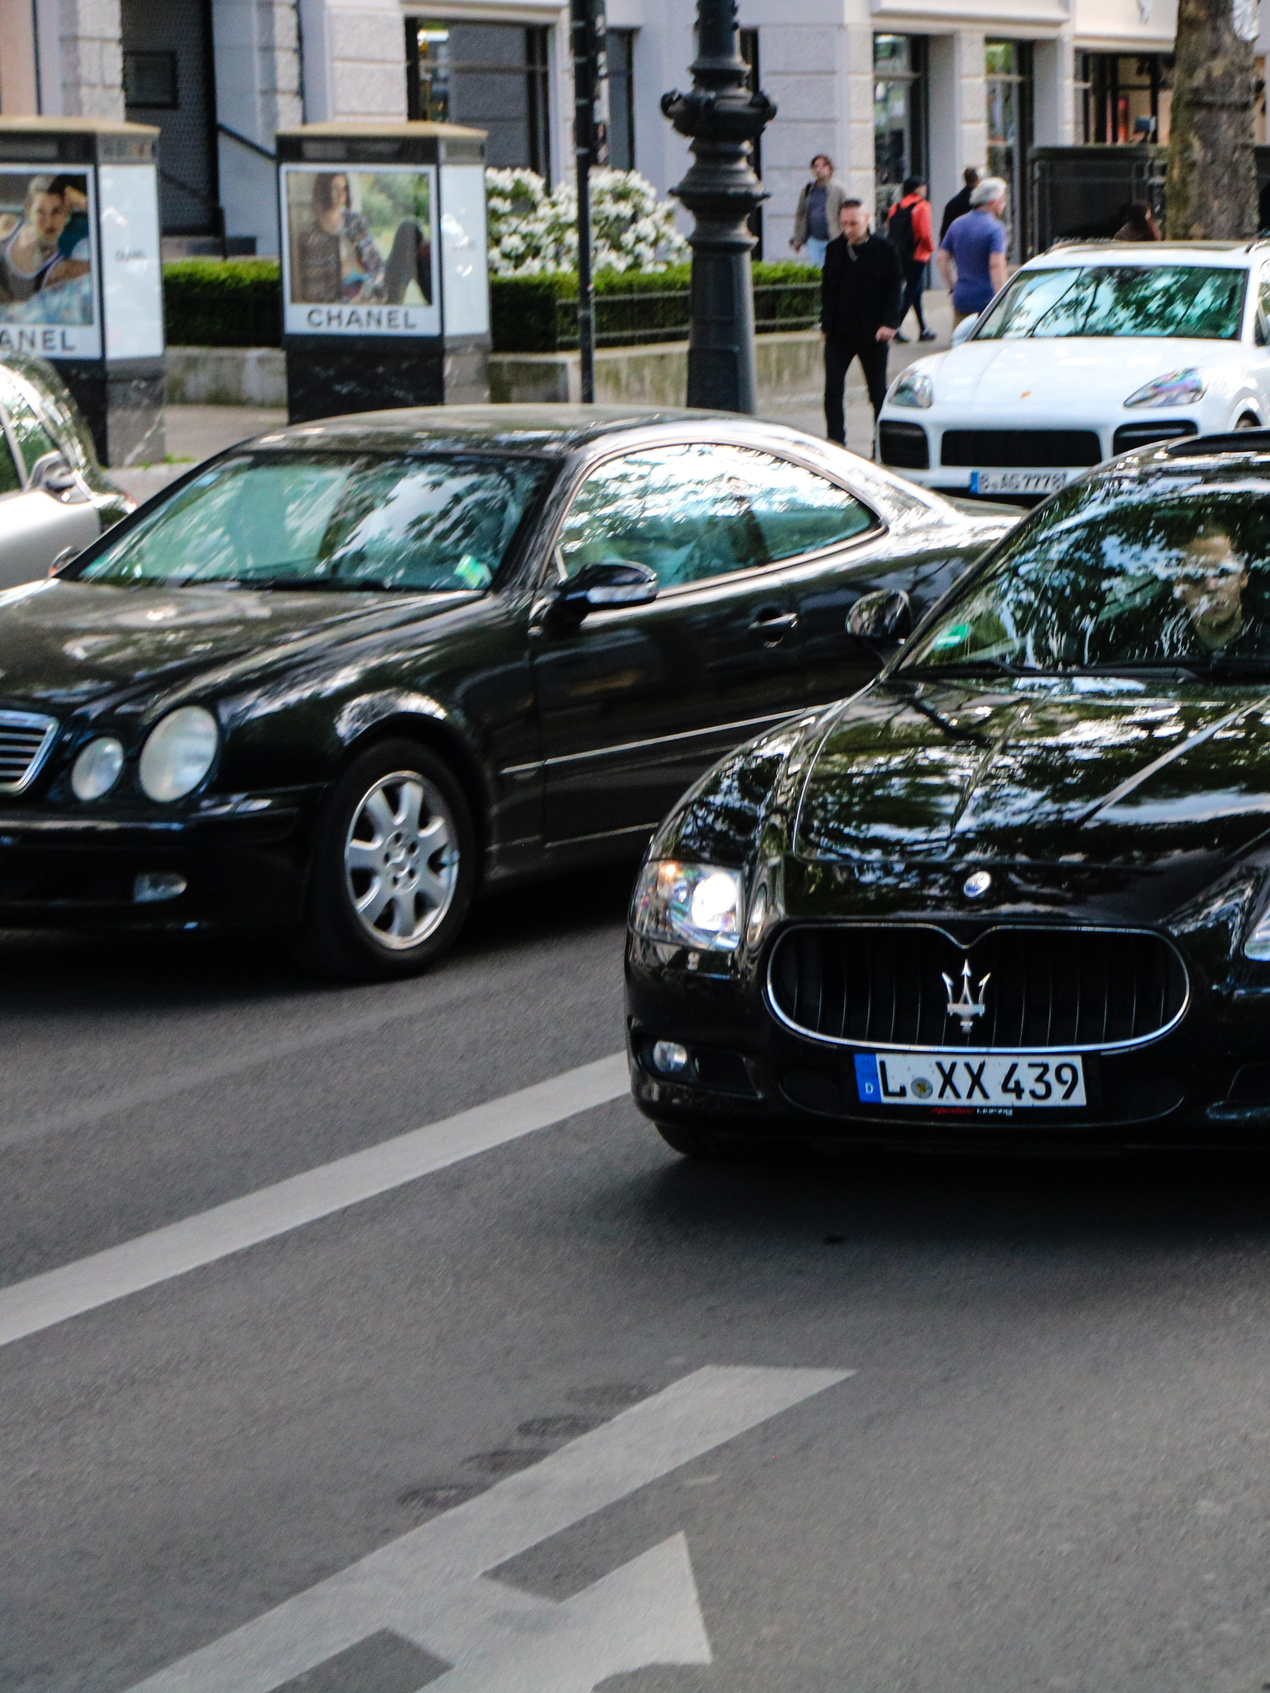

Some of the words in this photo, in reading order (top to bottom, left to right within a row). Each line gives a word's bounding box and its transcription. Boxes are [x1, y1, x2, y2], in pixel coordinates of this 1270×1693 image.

[307, 308, 417, 329] CHANEL
[865, 1082, 874, 1095] D
[879, 1060, 907, 1098] L
[935, 1060, 991, 1100] XX
[1001, 1062, 1079, 1101] 439
